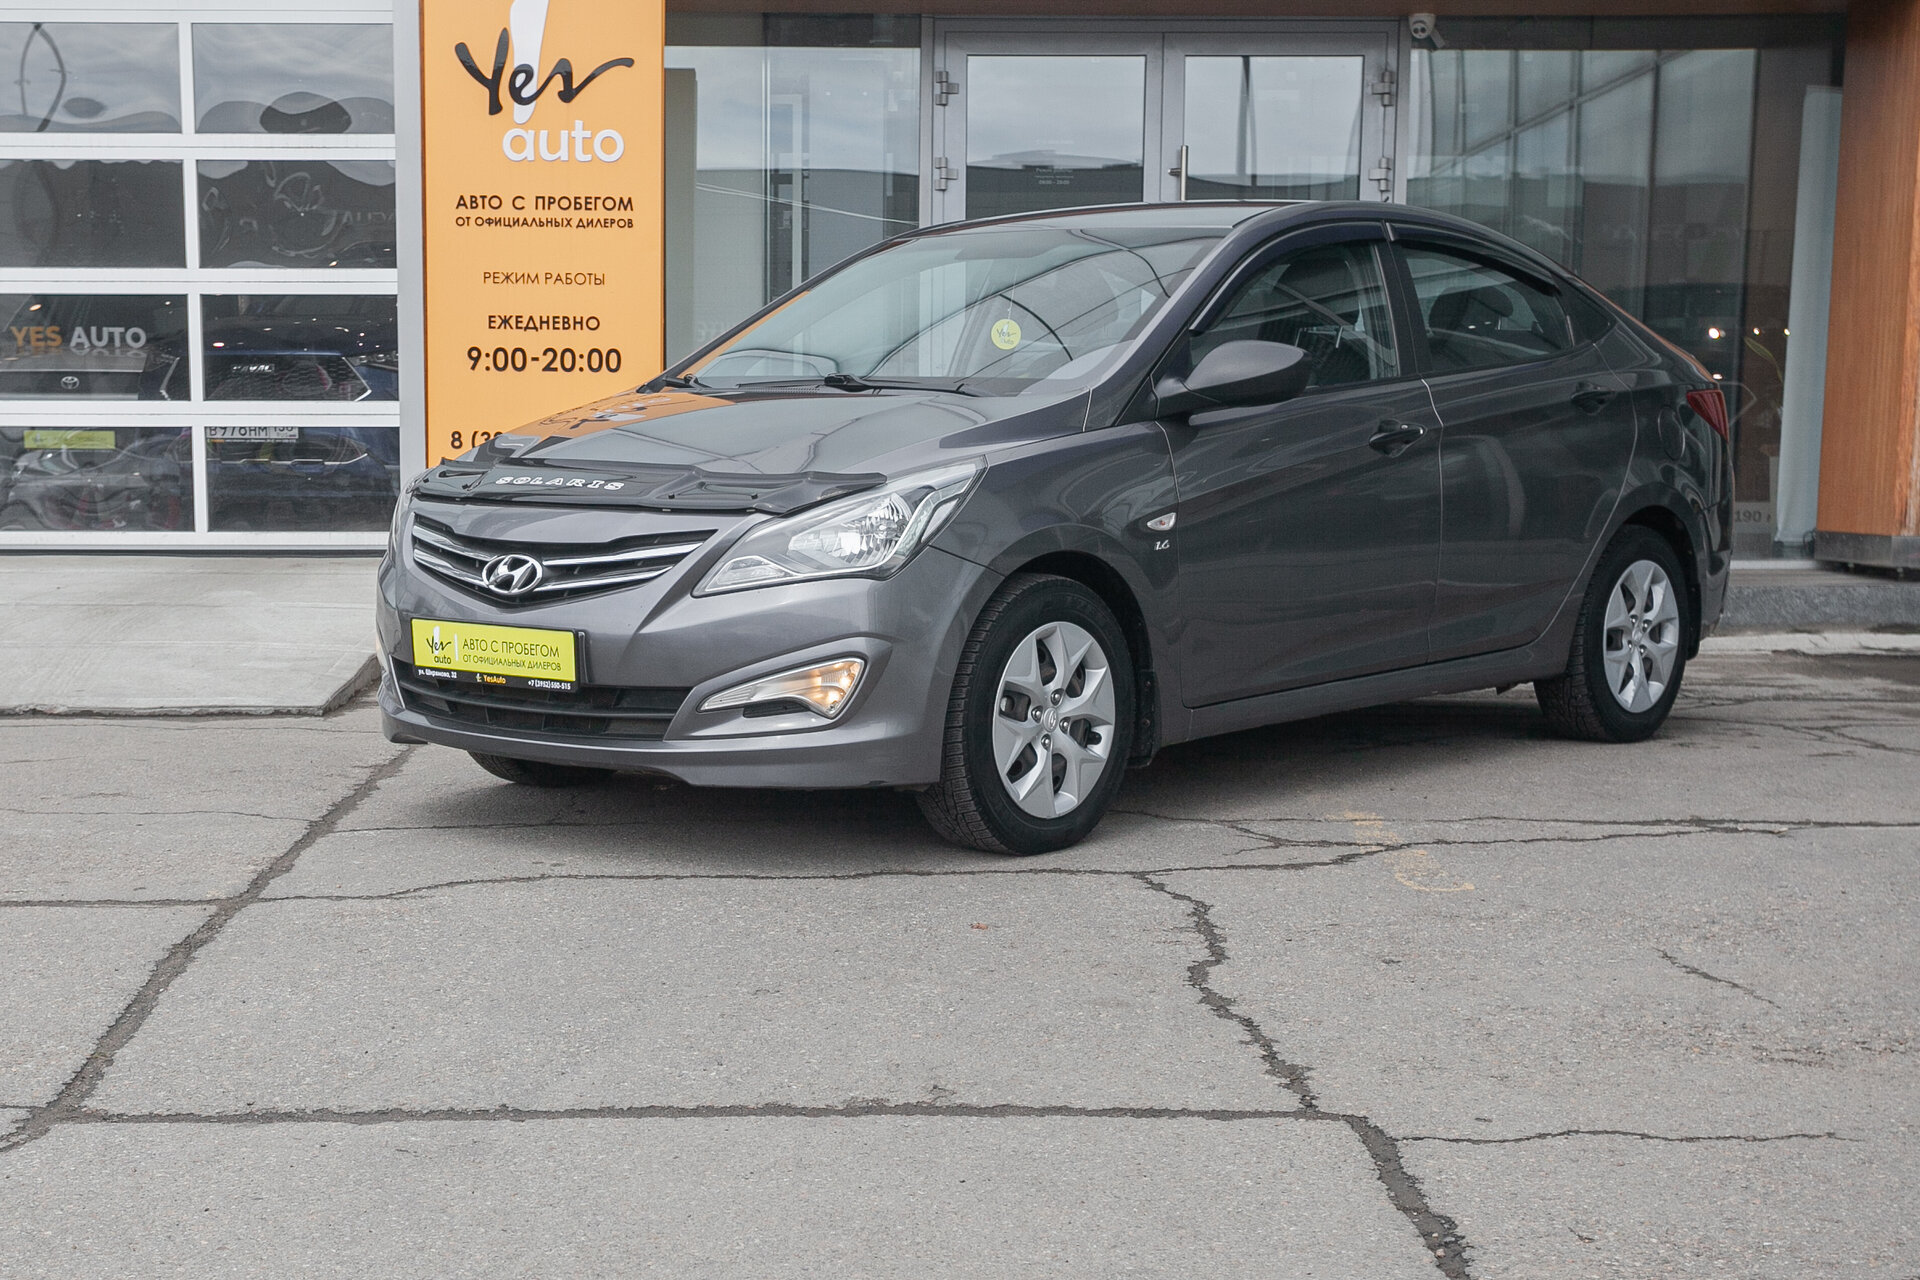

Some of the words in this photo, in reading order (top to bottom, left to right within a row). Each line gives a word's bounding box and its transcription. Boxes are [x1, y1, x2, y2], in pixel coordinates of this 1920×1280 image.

[454, 27, 635, 116] Yes
[502, 120, 625, 162] auto
[455, 195, 503, 210] АВТО
[511, 195, 526, 211] С
[535, 196, 634, 212] ПРОБЕГОМ
[455, 216, 471, 227] ОТ
[474, 216, 573, 229] ОФИЦИАЛЬНЫХ
[576, 218, 634, 229] ДИЛЕРОВ
[483, 271, 540, 285] РЕЖИМ
[544, 272, 605, 286] РАБОТЫ
[487, 315, 601, 332] ЕЖЕДНЕВНО
[9, 325, 63, 347] YES
[69, 326, 147, 349] AUTO
[466, 346, 622, 373] 9:00-20:00
[450, 430, 463, 450] 8
[495, 476, 625, 491] SOLARIS
[425, 635, 452, 654] Yes
[462, 638, 488, 652] АВТО
[490, 640, 499, 653] С
[501, 641, 560, 658] ПРОБЕГОМ
[433, 655, 452, 665] auto
[462, 654, 472, 663] ОТ
[473, 655, 526, 669] ОФИЦИАЛЬНЫХ
[527, 660, 562, 672] ДИЛЕРОВ
